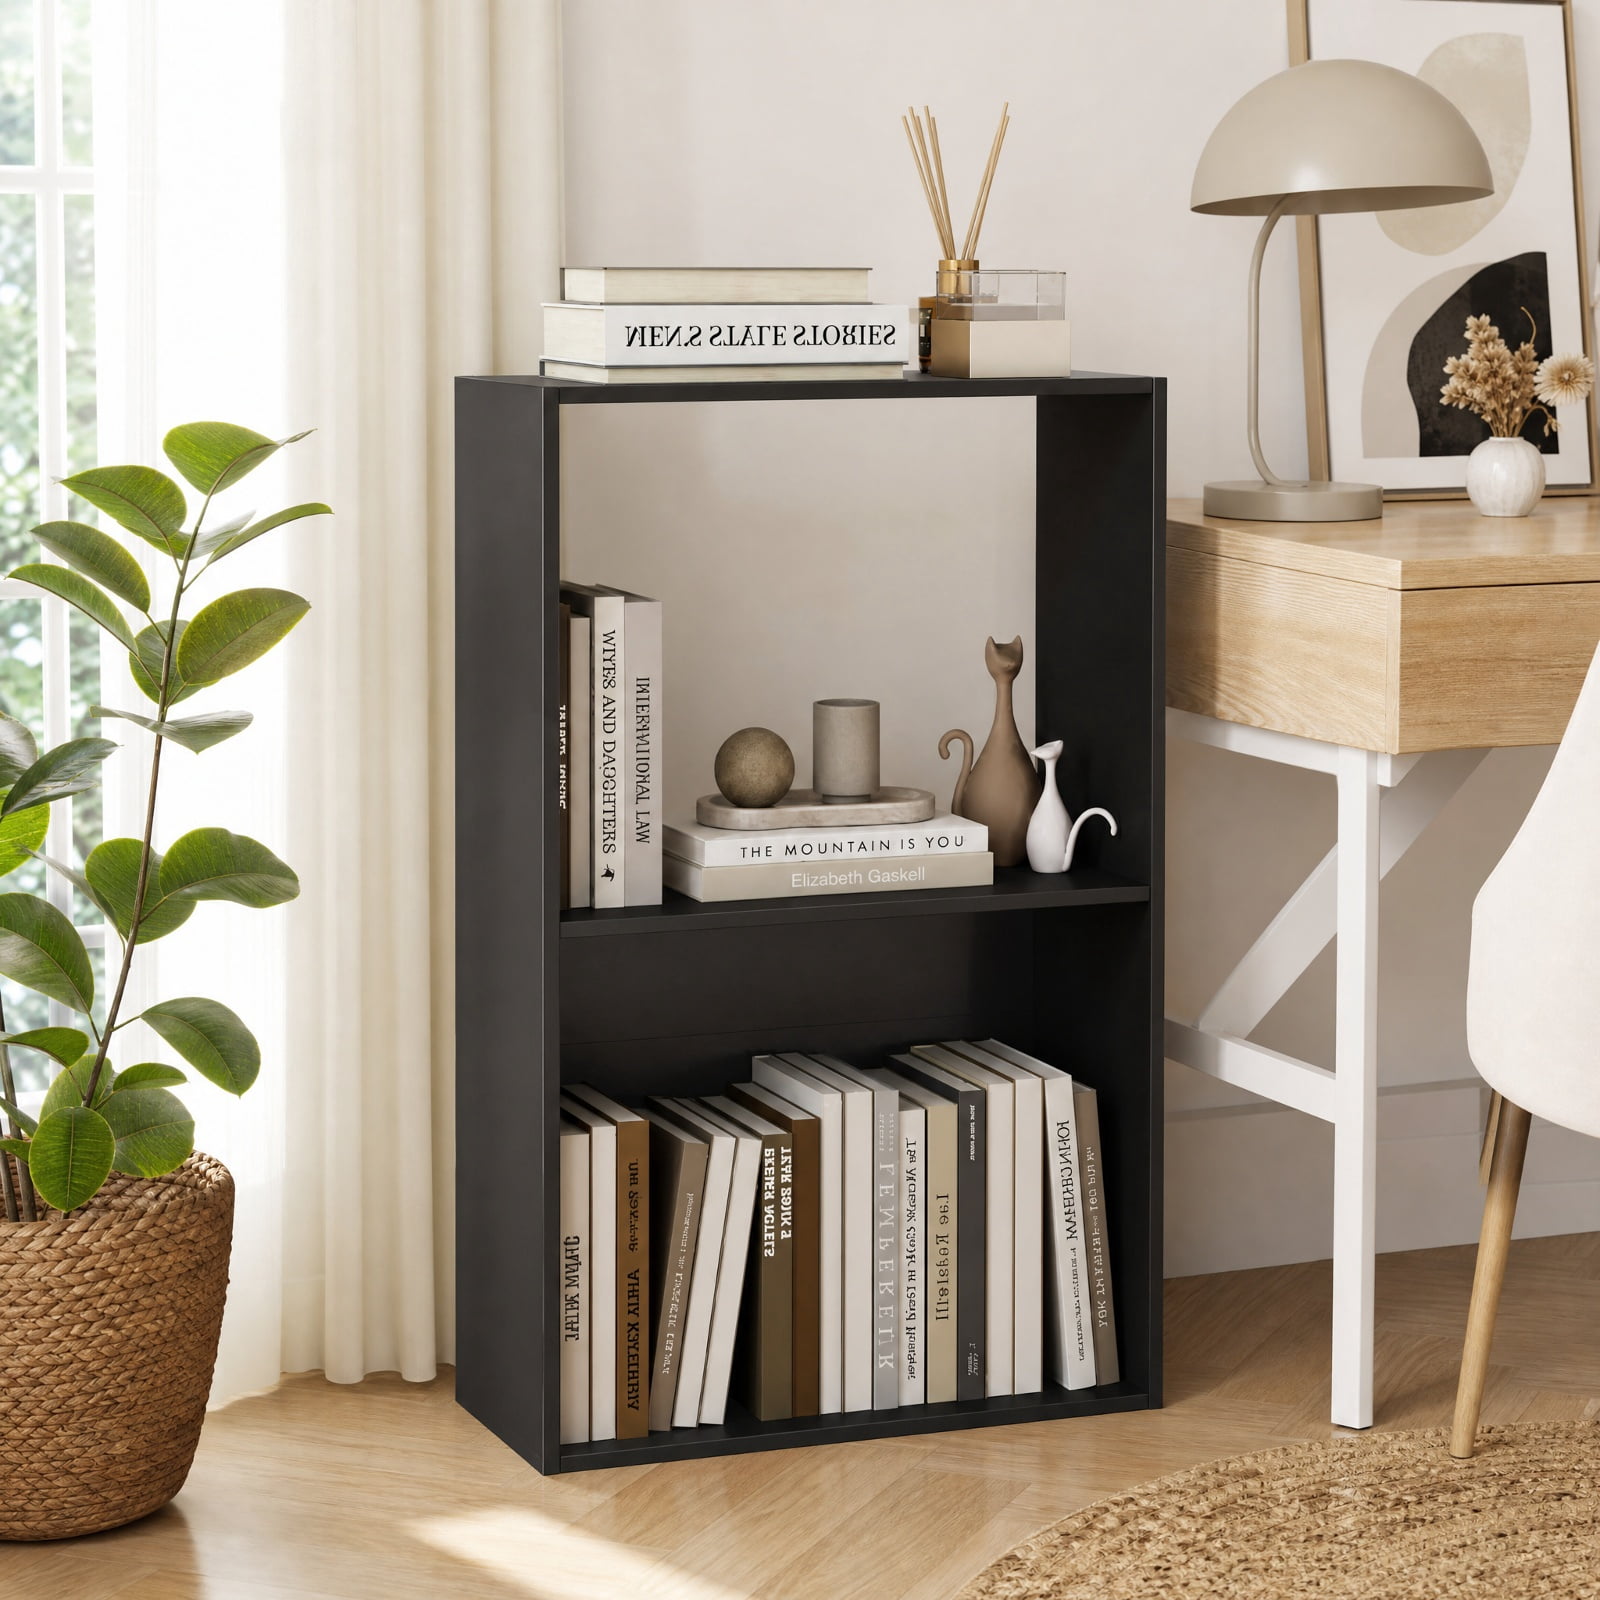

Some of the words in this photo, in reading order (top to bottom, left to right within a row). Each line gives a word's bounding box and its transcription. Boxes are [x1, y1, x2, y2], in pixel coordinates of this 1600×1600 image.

[602, 695, 616, 734] AND
[636, 810, 650, 844] LAW
[740, 846, 773, 859] THE
[784, 839, 891, 856] MOUNTAIN
[900, 838, 915, 850] IS
[925, 835, 965, 849] YOU
[791, 869, 863, 888] Elizabeth
[868, 866, 925, 884] Gaskell
